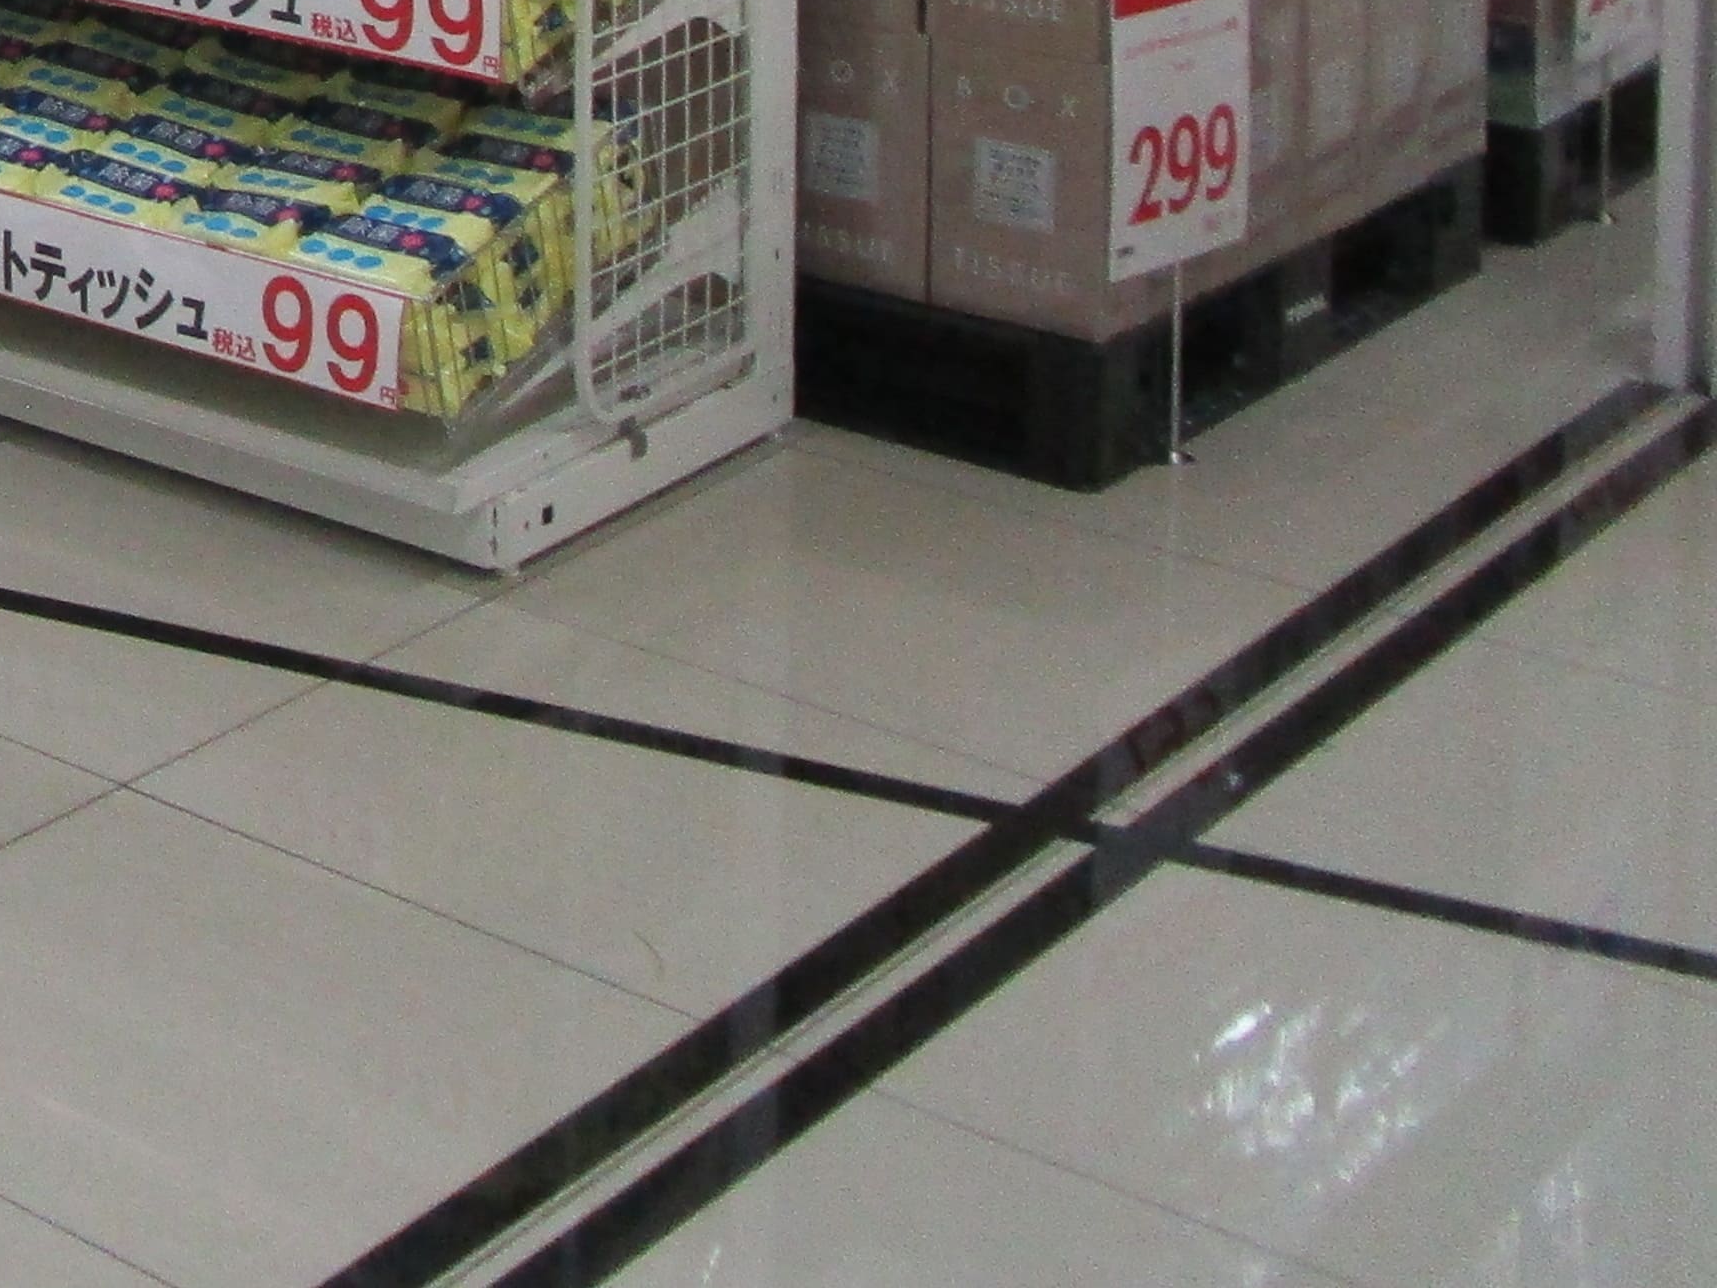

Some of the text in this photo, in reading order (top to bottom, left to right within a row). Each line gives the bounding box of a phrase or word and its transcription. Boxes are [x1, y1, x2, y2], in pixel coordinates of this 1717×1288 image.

[310, 12, 359, 44] 税込
[1128, 103, 1238, 225] 299
[211, 326, 257, 363] 税込
[262, 274, 380, 392] 99
